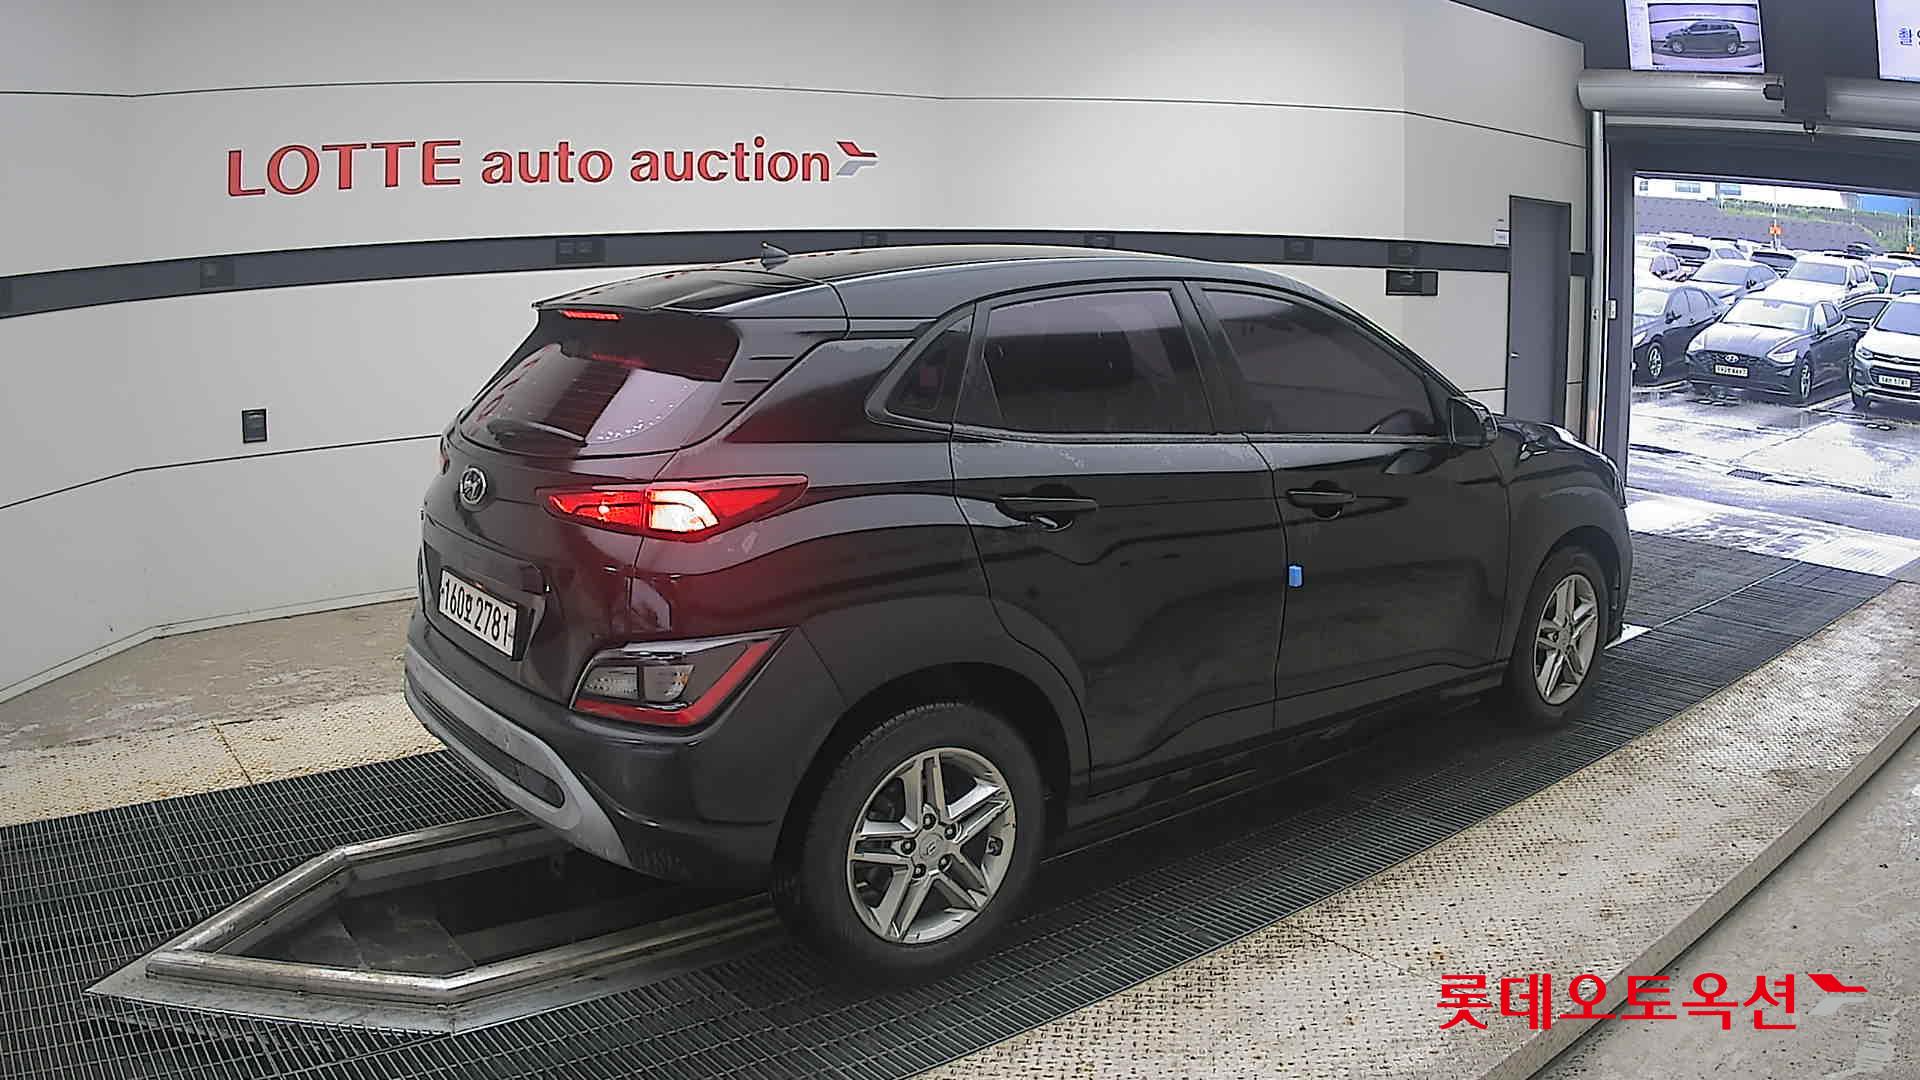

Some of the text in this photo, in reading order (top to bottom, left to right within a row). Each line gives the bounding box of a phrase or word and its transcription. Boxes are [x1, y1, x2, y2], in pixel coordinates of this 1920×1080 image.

[226, 135, 831, 197] LOTTE auto auction
[474, 597, 510, 647] 2781
